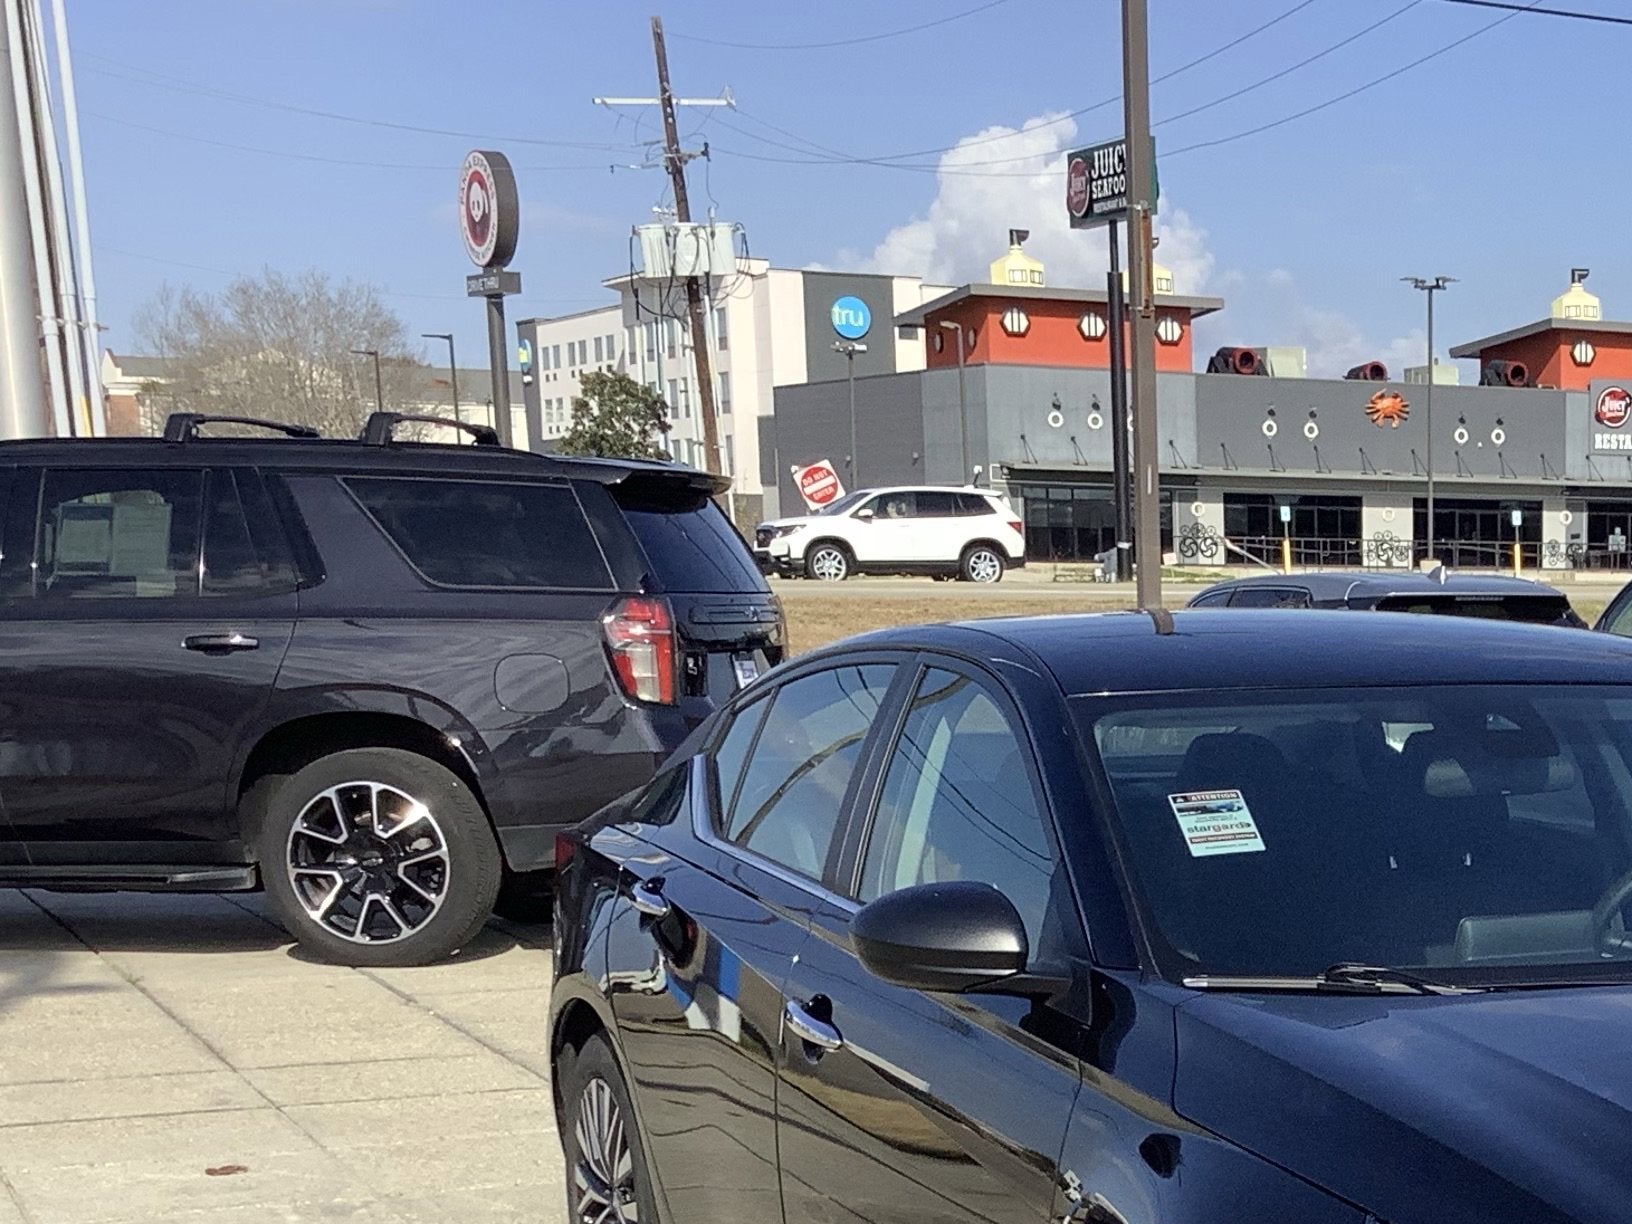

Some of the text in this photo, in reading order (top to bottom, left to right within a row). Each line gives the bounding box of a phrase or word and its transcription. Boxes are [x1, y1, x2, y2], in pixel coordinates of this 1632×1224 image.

[1091, 174, 1127, 200] SEAFOO
[831, 303, 864, 327] tru
[802, 469, 828, 487] DO NOT
[812, 486, 835, 501] ENTER
[1191, 791, 1238, 801] ATTENTION
